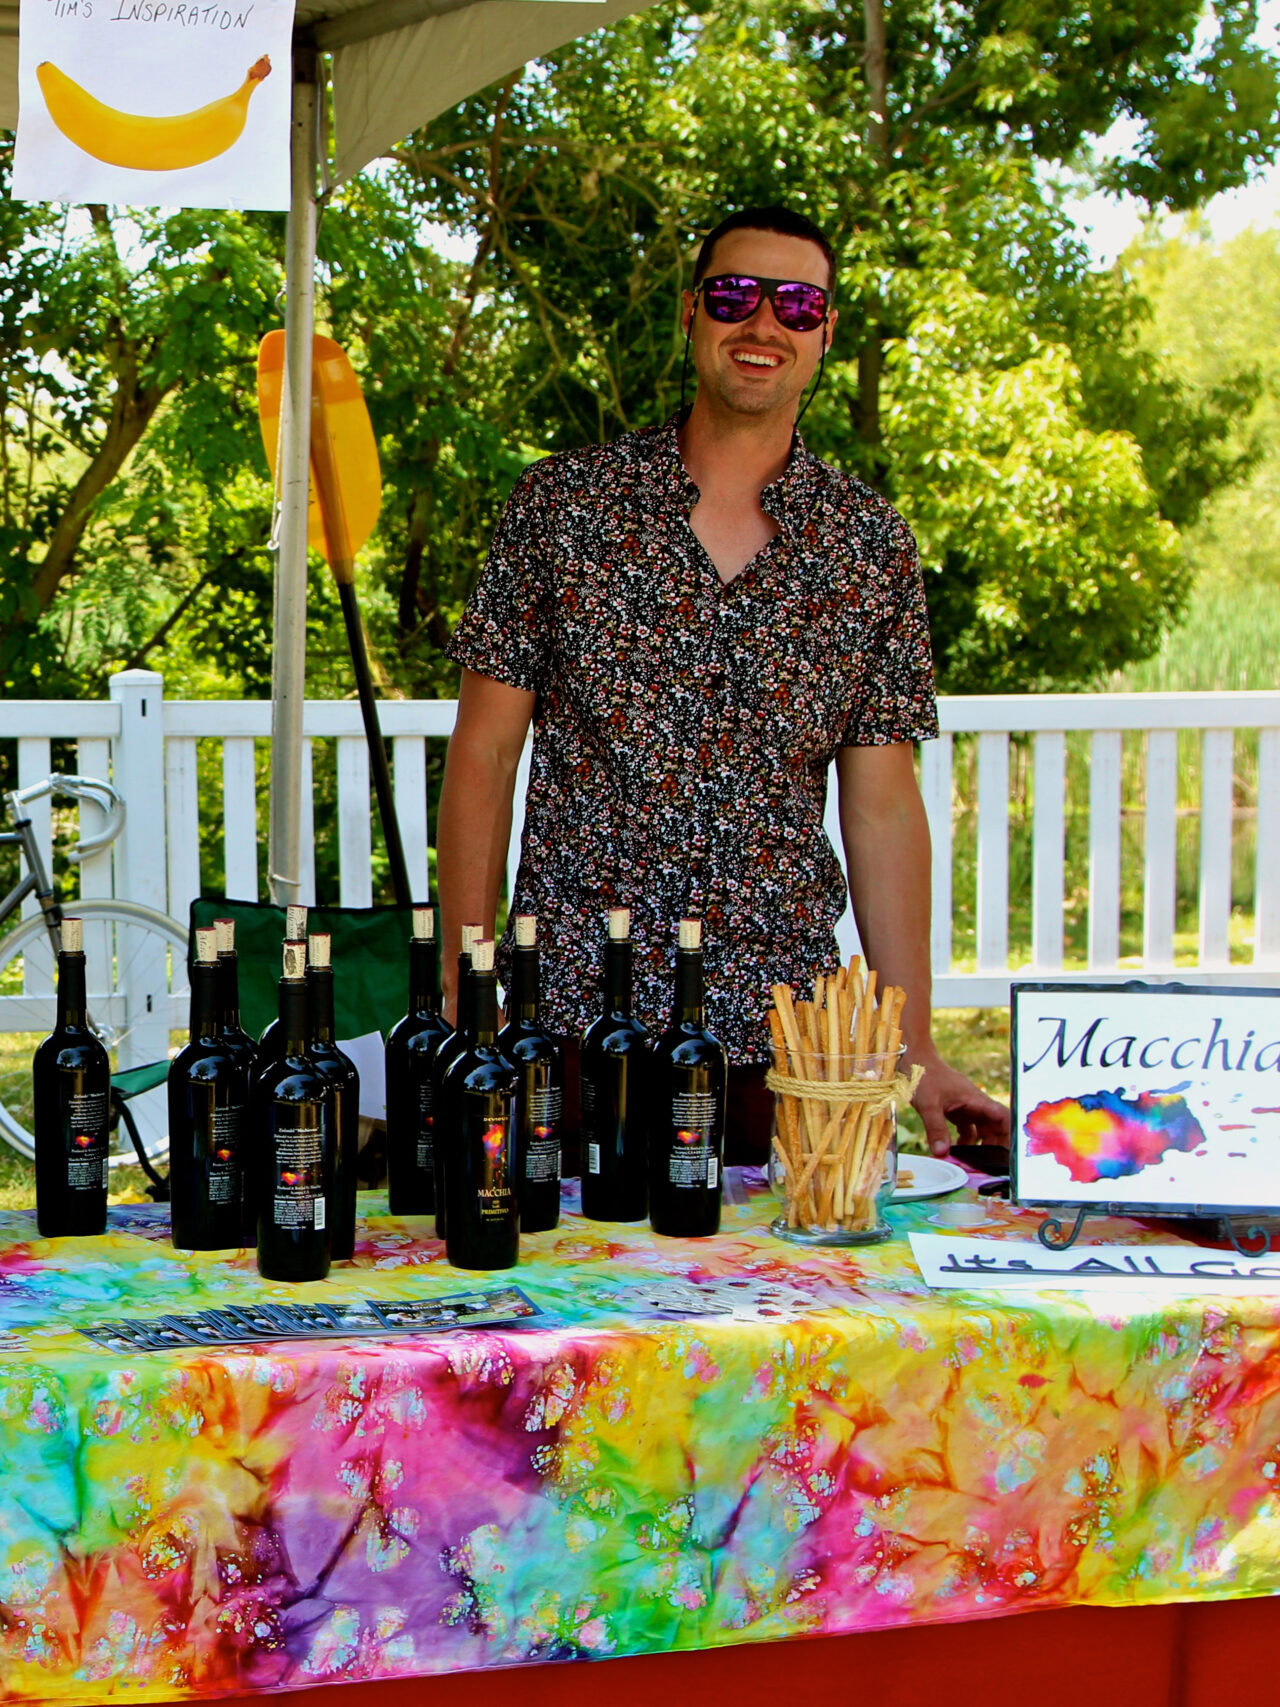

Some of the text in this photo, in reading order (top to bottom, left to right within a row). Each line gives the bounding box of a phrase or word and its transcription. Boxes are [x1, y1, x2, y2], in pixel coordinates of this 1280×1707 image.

[110, 0, 254, 30] INSPIRATION
[477, 1187, 512, 1198] MACCHIA
[1069, 1255, 1163, 1275] All
